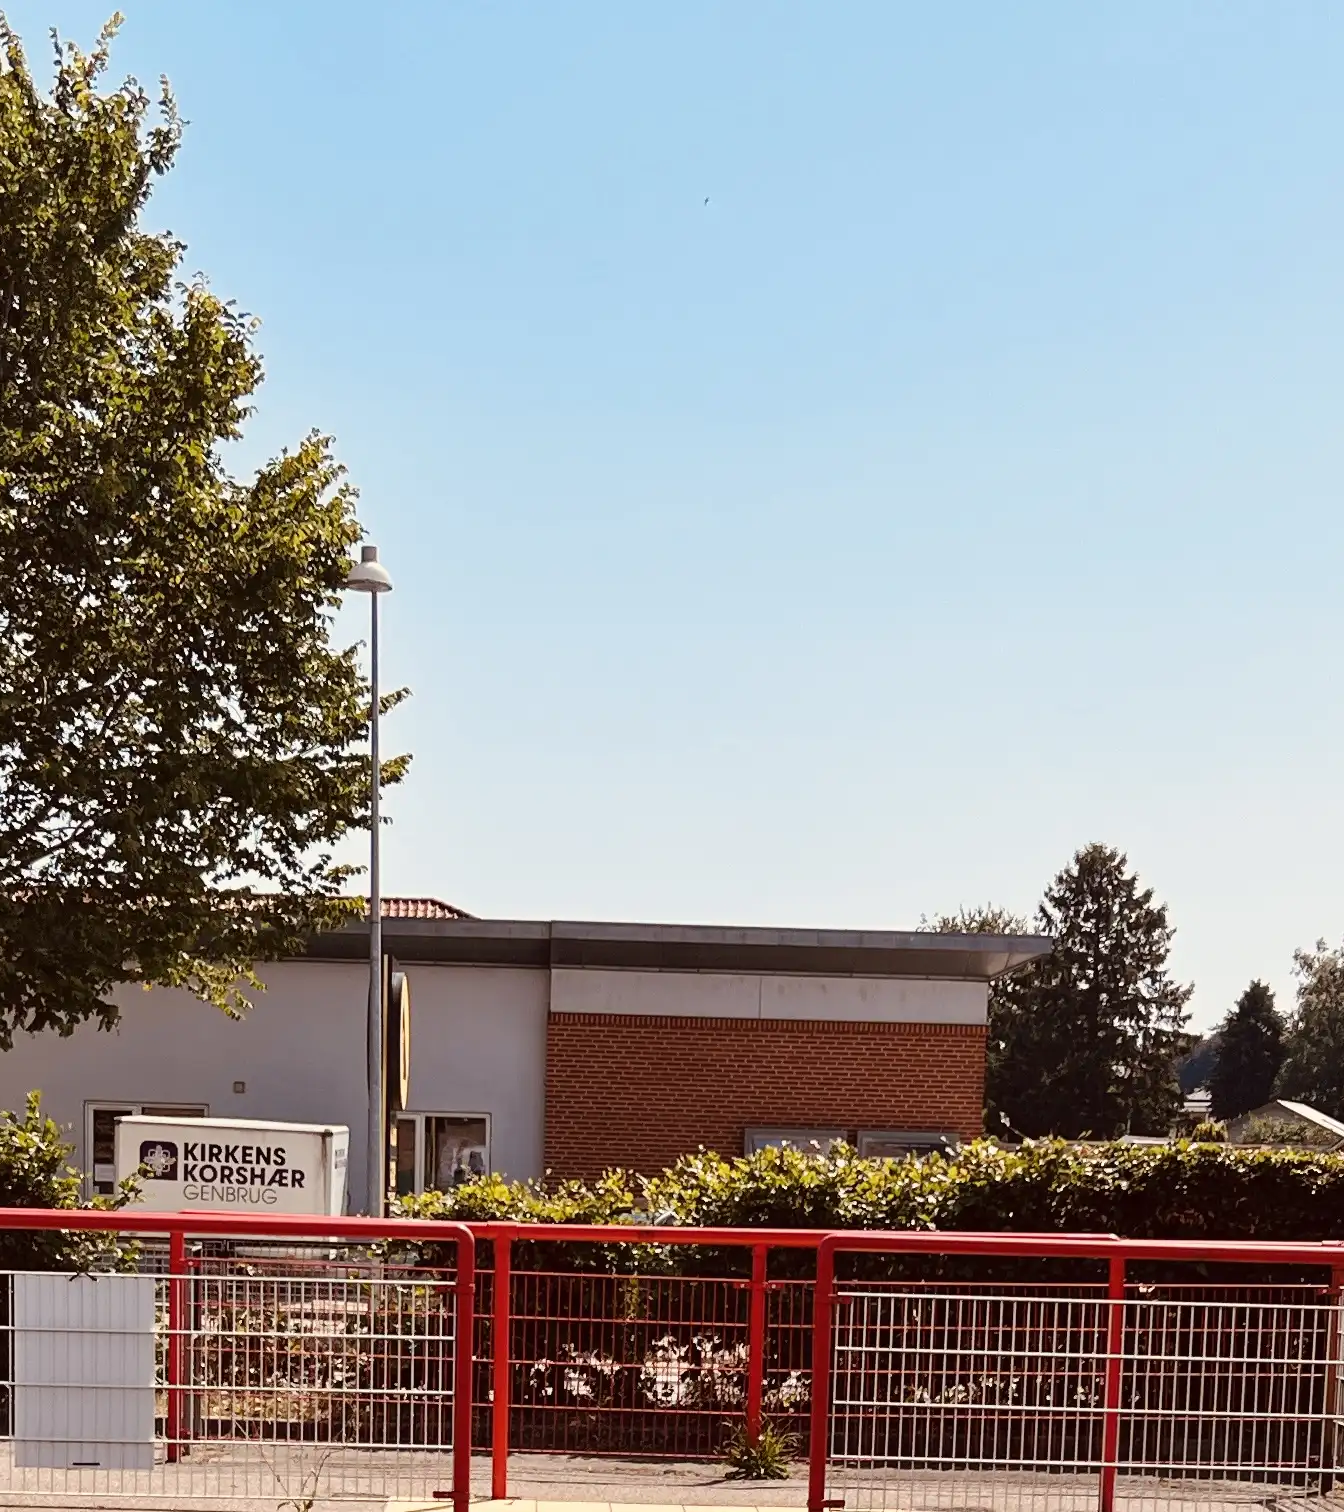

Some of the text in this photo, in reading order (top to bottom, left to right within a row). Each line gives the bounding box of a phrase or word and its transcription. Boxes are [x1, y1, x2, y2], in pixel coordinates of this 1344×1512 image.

[183, 1142, 286, 1166] KIRKENS
[183, 1163, 306, 1189] KORSHÆR
[182, 1184, 278, 1205] GENBRUG
